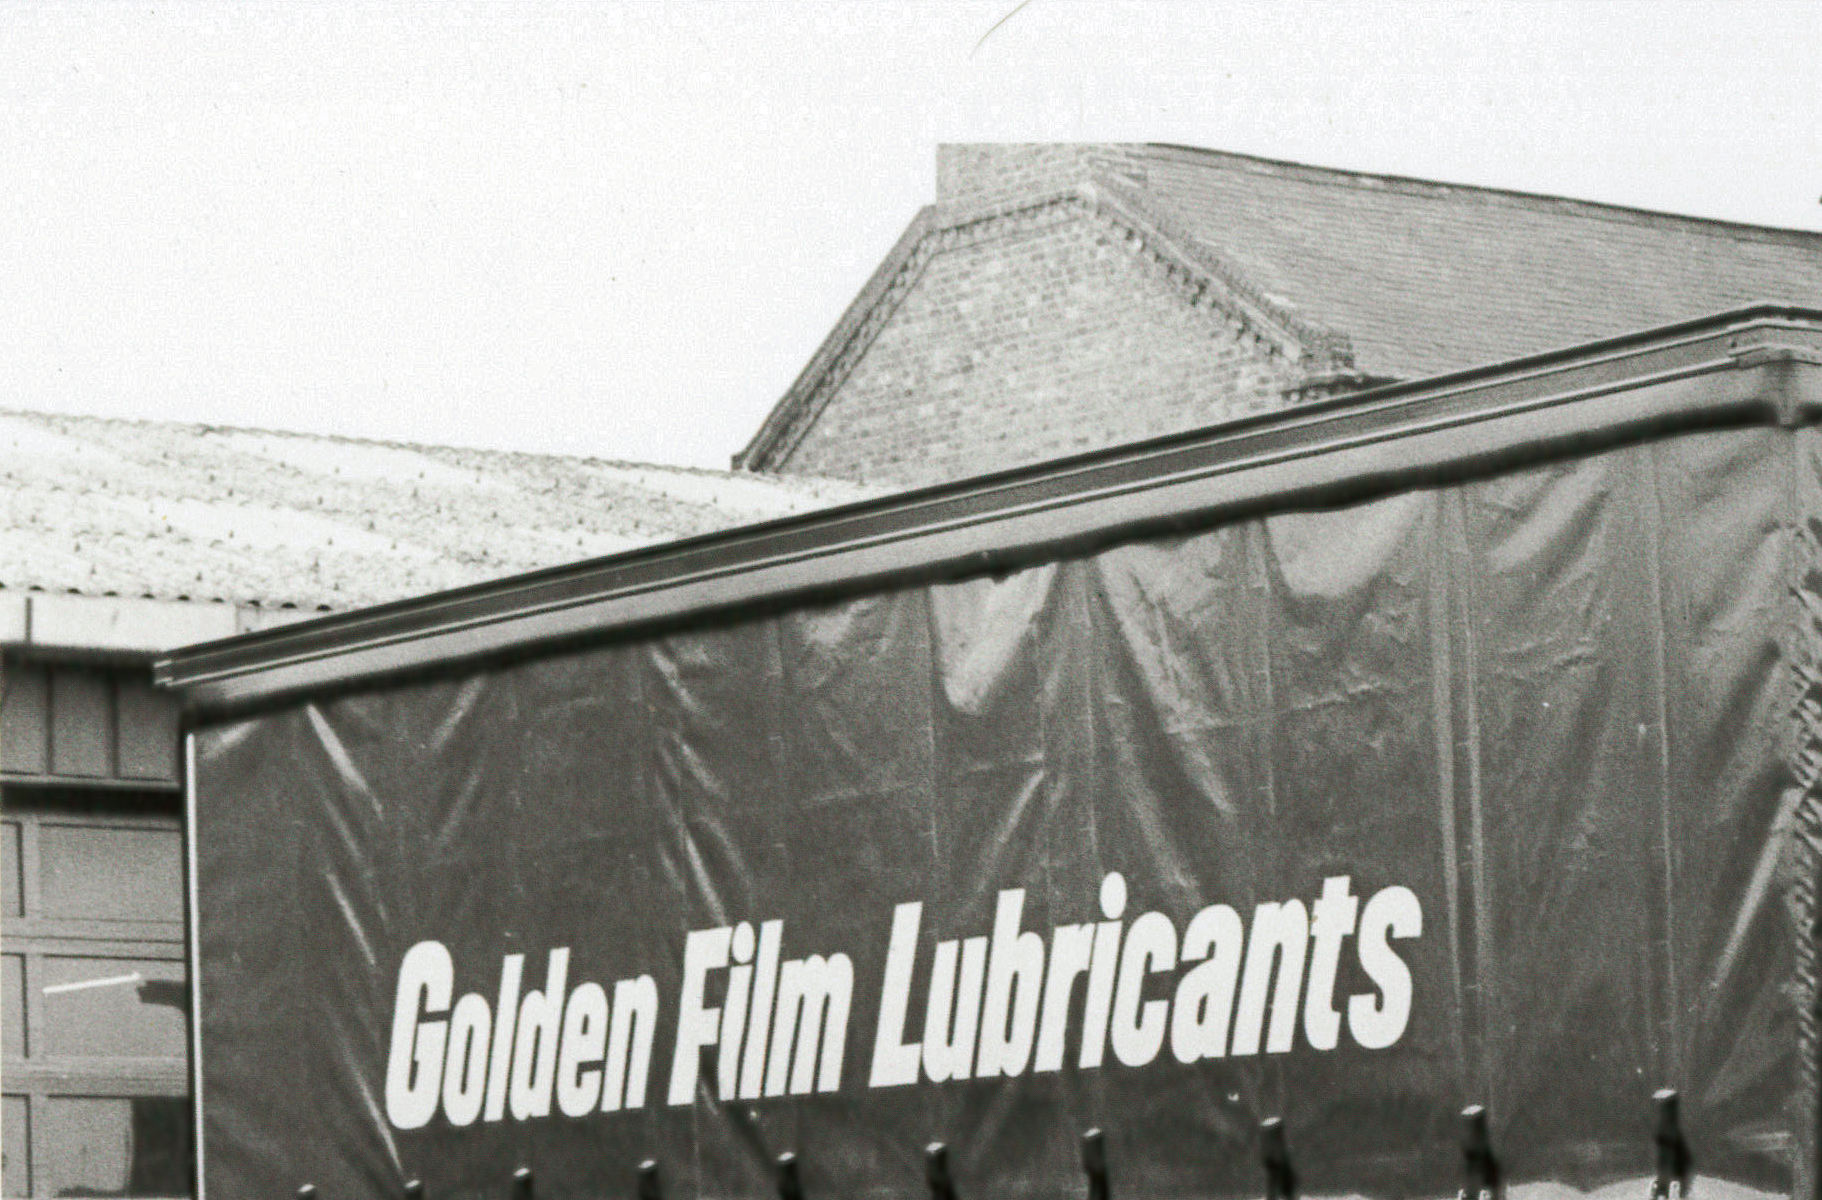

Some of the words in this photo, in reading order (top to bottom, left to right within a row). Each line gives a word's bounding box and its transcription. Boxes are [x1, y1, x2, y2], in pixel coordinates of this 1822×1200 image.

[385, 940, 658, 1129] Golden
[668, 919, 854, 1106] Film
[869, 871, 1422, 1088] Lubricants
